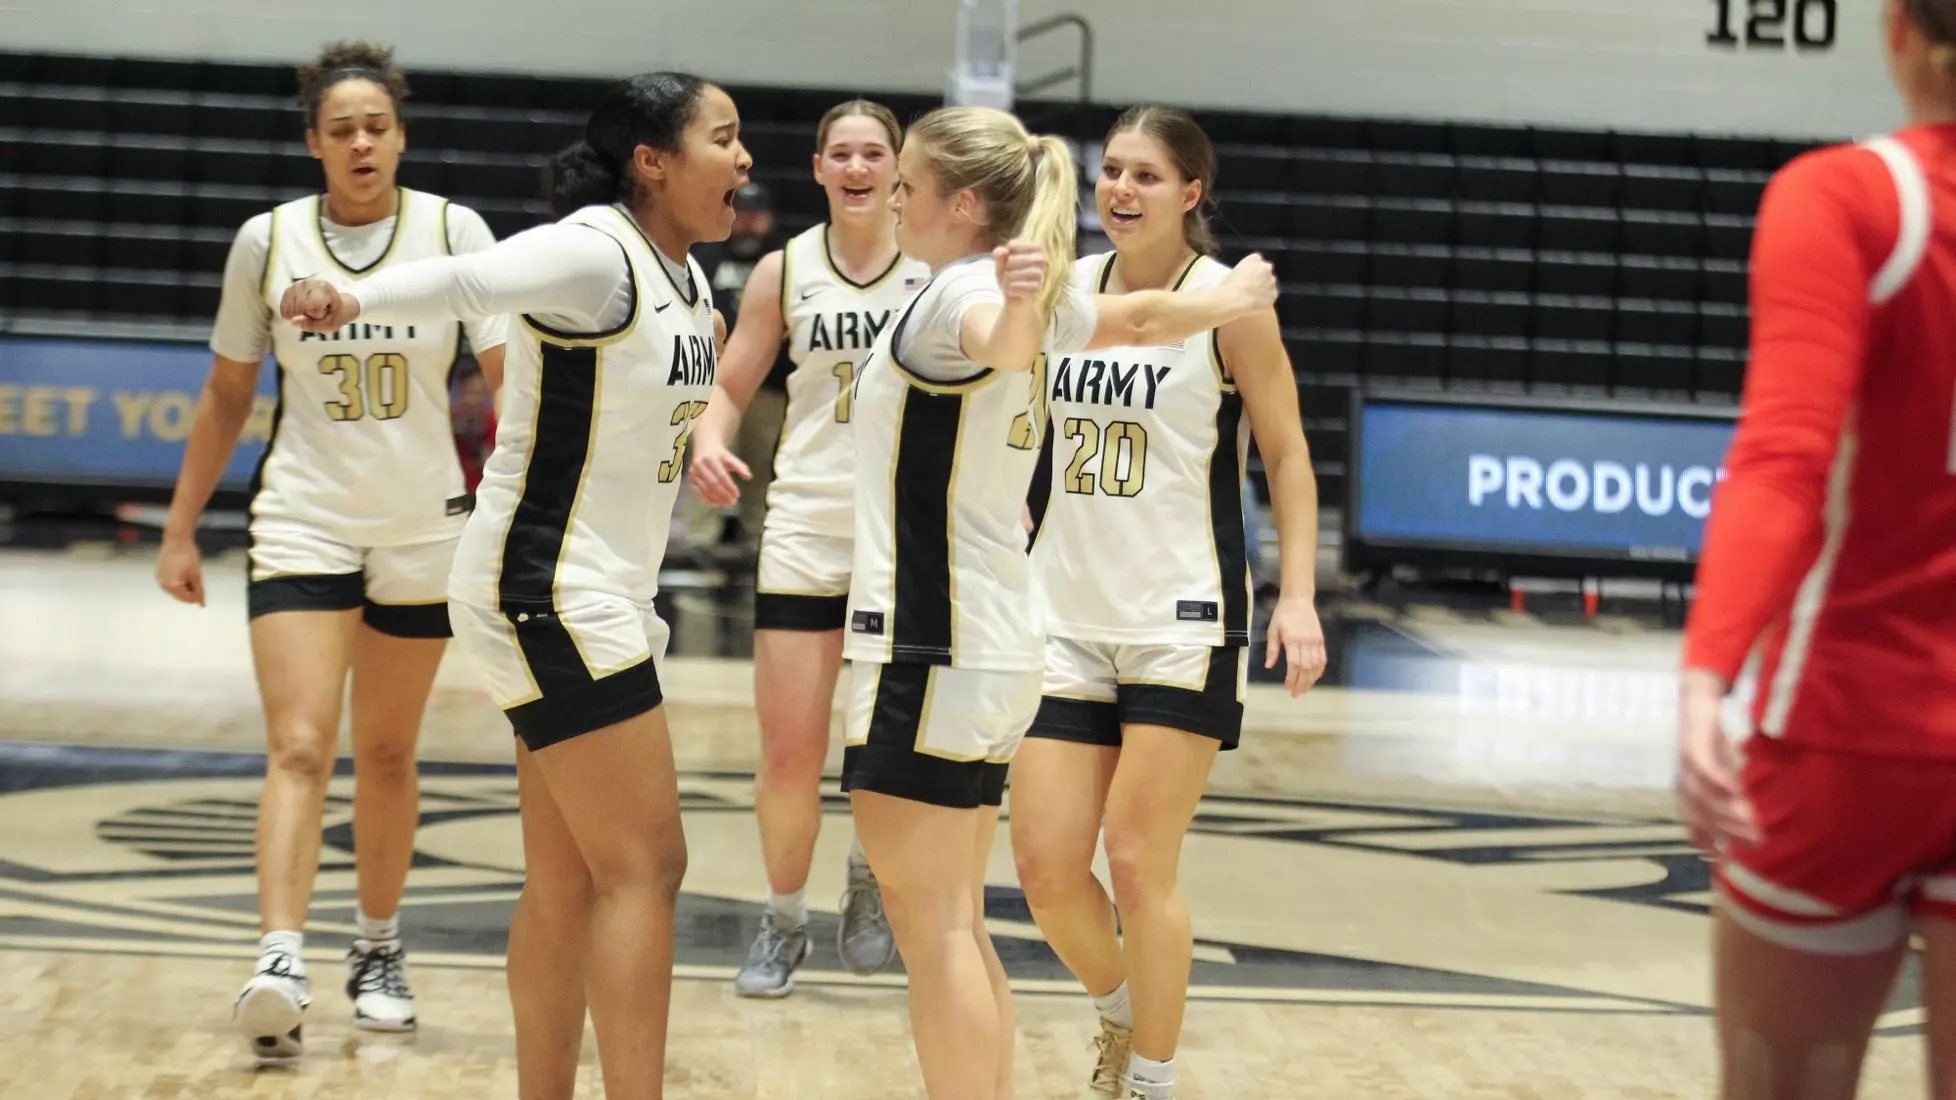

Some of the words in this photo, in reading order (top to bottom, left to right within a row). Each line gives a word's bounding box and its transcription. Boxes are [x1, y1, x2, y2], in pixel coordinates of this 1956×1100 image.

[1706, 0, 1837, 49] 120
[809, 309, 900, 352] ARM
[666, 334, 715, 386] ARM
[1052, 357, 1172, 410] ARMY
[317, 353, 408, 421] 30
[1063, 417, 1148, 498] 20
[1468, 453, 1727, 520] PRODUC
